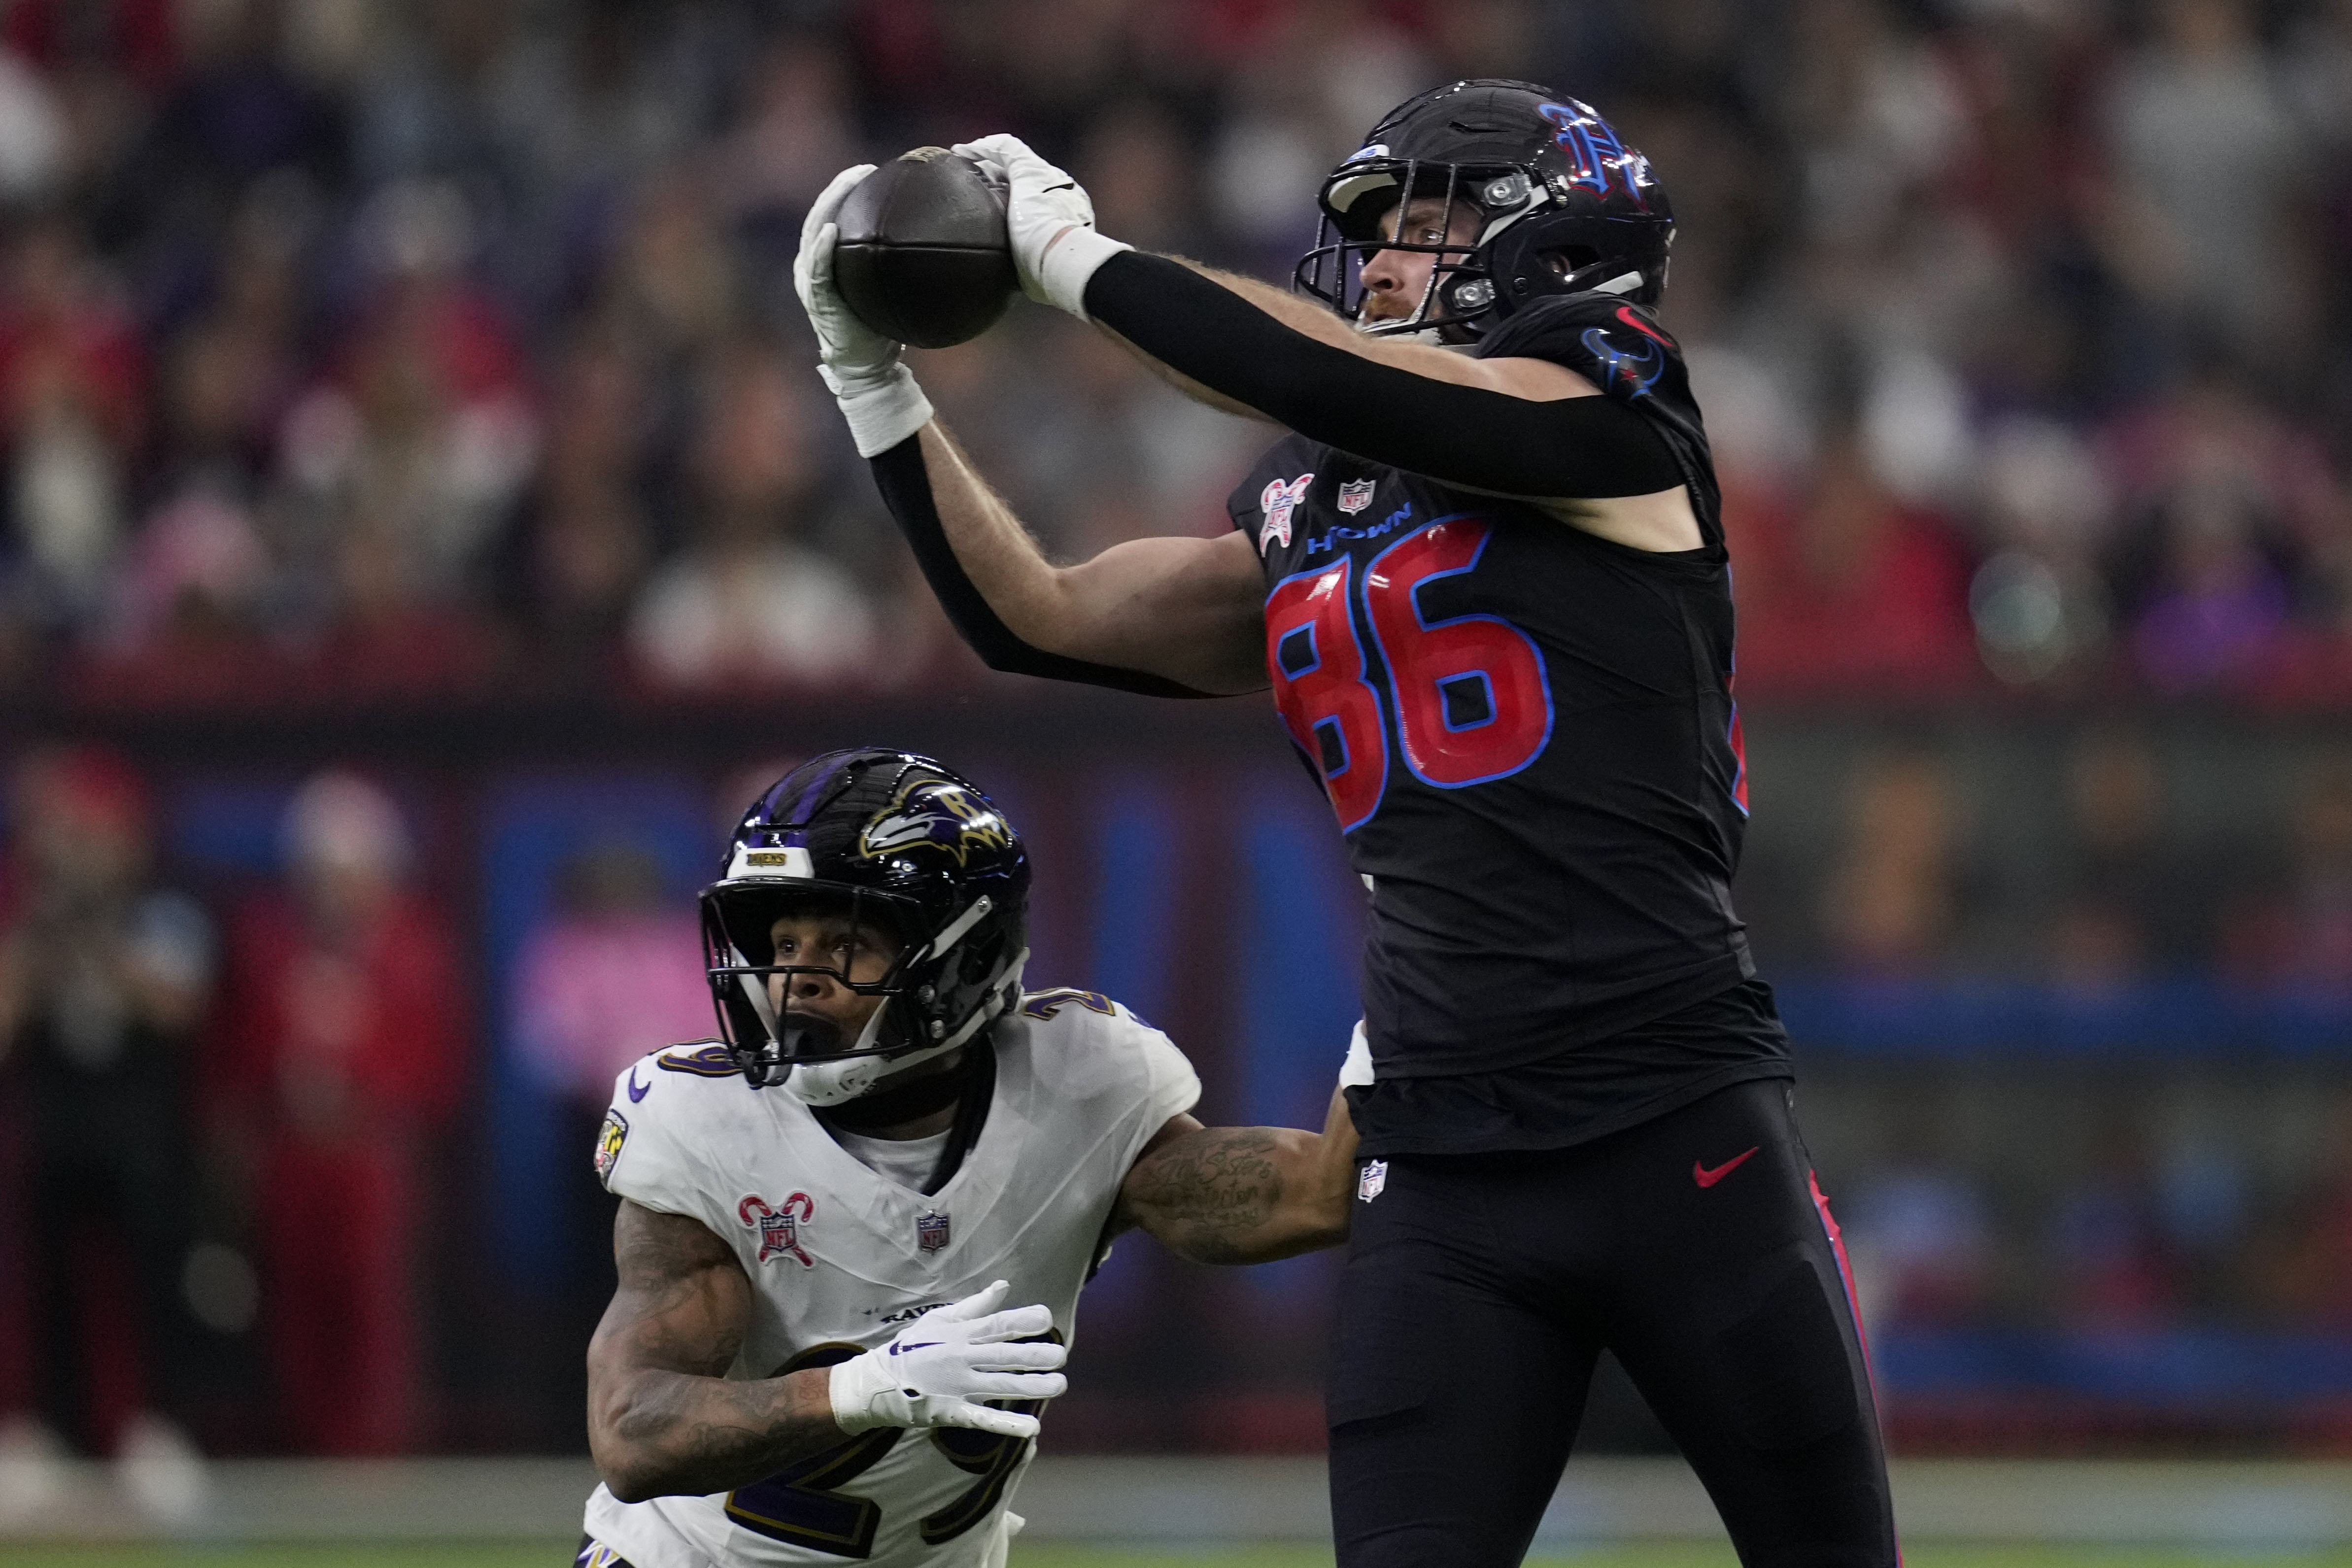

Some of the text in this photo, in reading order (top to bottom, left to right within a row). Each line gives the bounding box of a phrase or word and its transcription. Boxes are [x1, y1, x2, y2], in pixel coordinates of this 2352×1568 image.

[1264, 511, 1555, 836] 86
[1021, 987, 1116, 1021] 2
[648, 1037, 743, 1078] 9
[766, 1228, 793, 1246] NFL
[922, 1229, 948, 1247] NFL
[879, 1302, 954, 1324] RAVE
